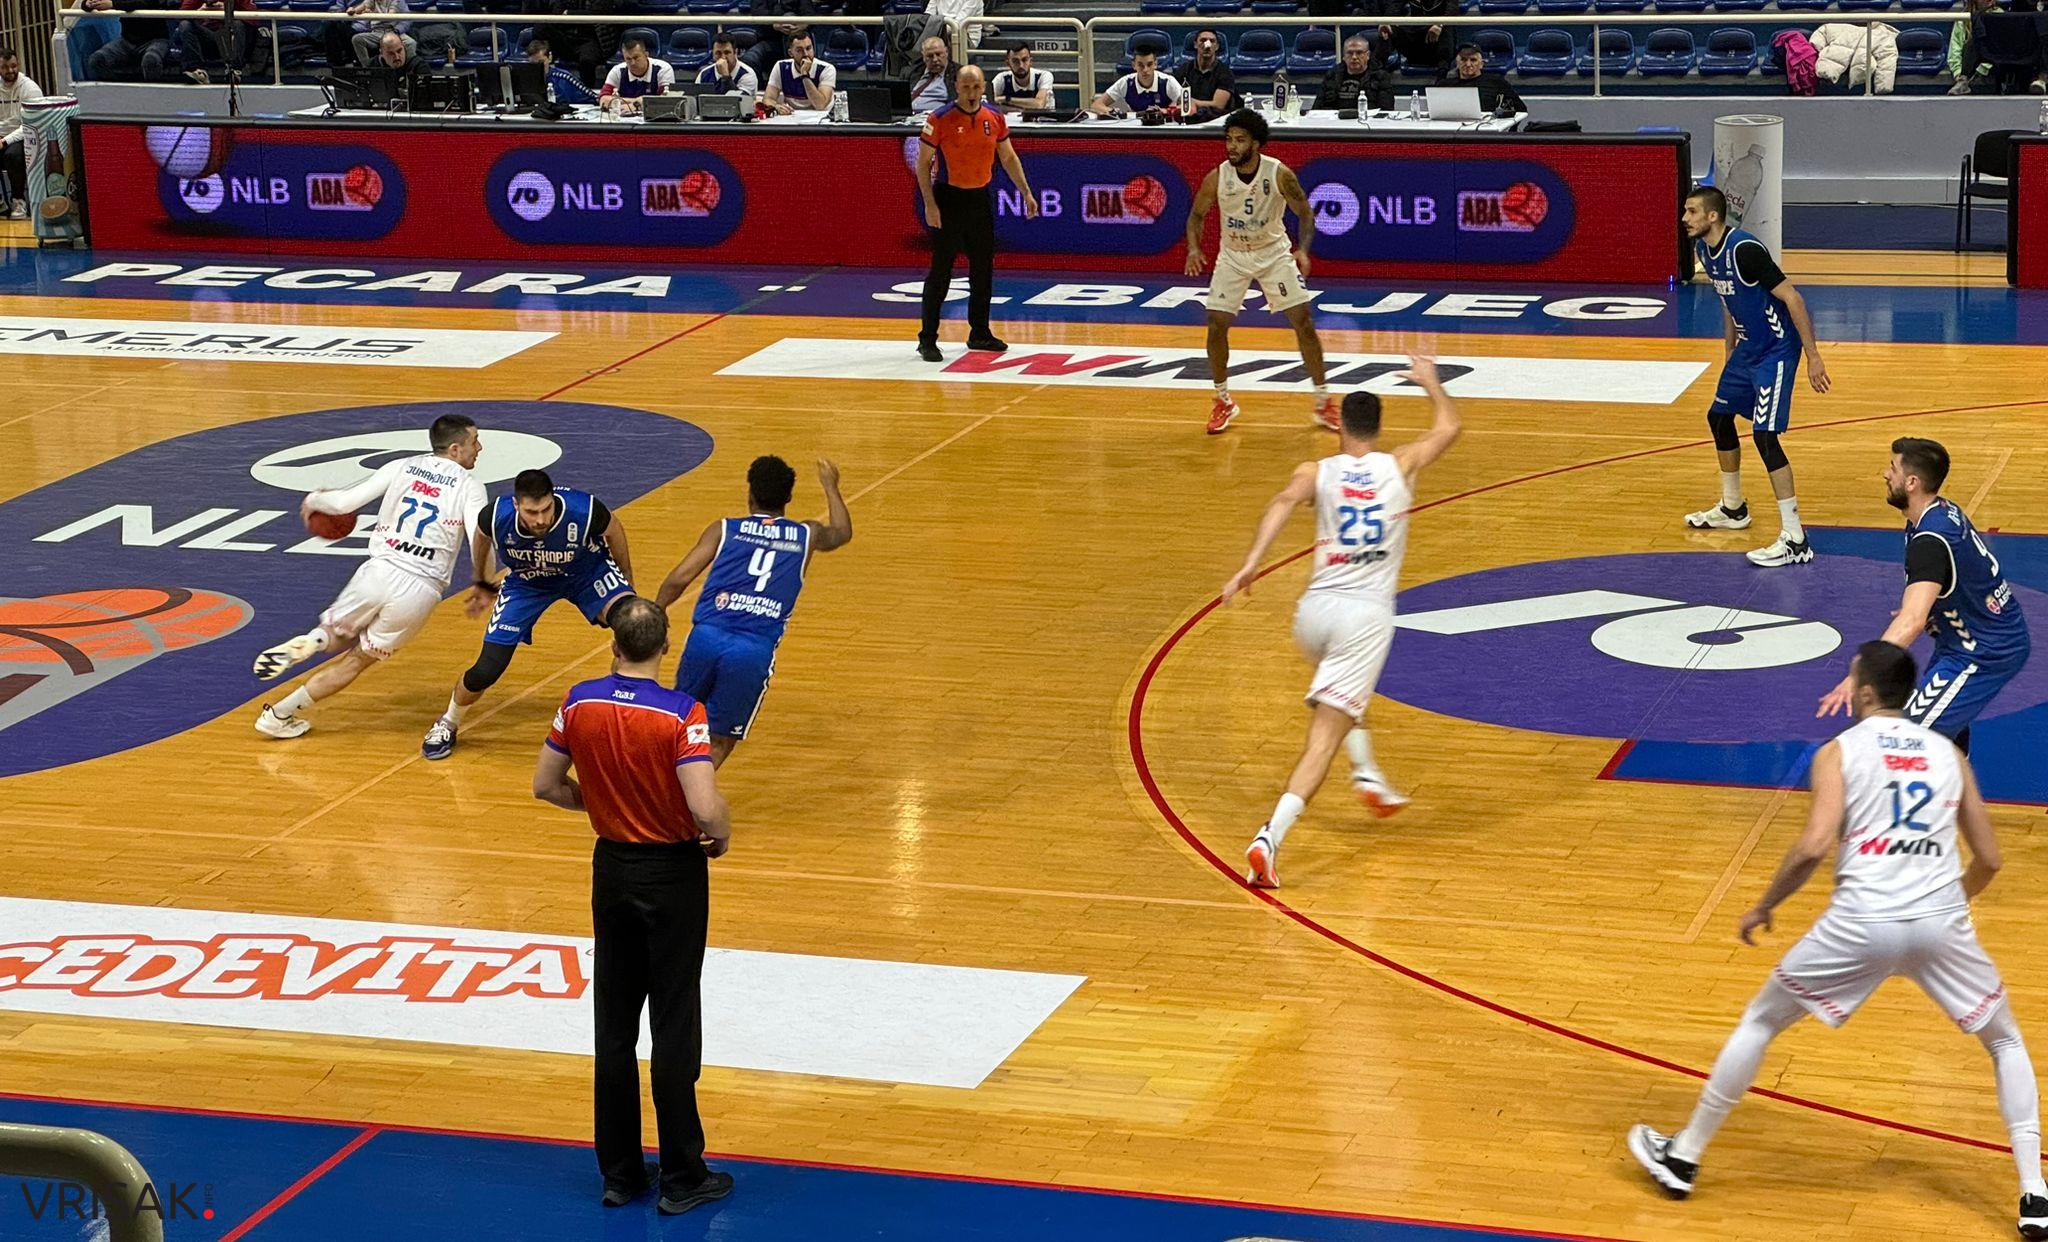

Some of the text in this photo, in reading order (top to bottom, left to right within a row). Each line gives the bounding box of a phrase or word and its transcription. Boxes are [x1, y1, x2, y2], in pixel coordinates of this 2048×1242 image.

[1037, 42, 1069, 51] RED 1
[231, 177, 291, 205] NLB
[311, 178, 345, 206] ABA
[562, 182, 624, 211] NLB
[645, 184, 680, 212] ABA
[1086, 190, 1124, 219] ABA
[1244, 198, 1254, 215] 5
[1368, 195, 1437, 225] NLB
[1461, 197, 1501, 226] ABA
[60, 262, 672, 298] PECARA
[95, 345, 392, 359] ALUMINIUM EXTRUSION
[411, 480, 441, 498] FAKS
[395, 496, 440, 539] 77
[1337, 503, 1384, 546] 25
[784, 526, 799, 542] III
[747, 547, 777, 592] 4
[1883, 781, 1934, 832] 12
